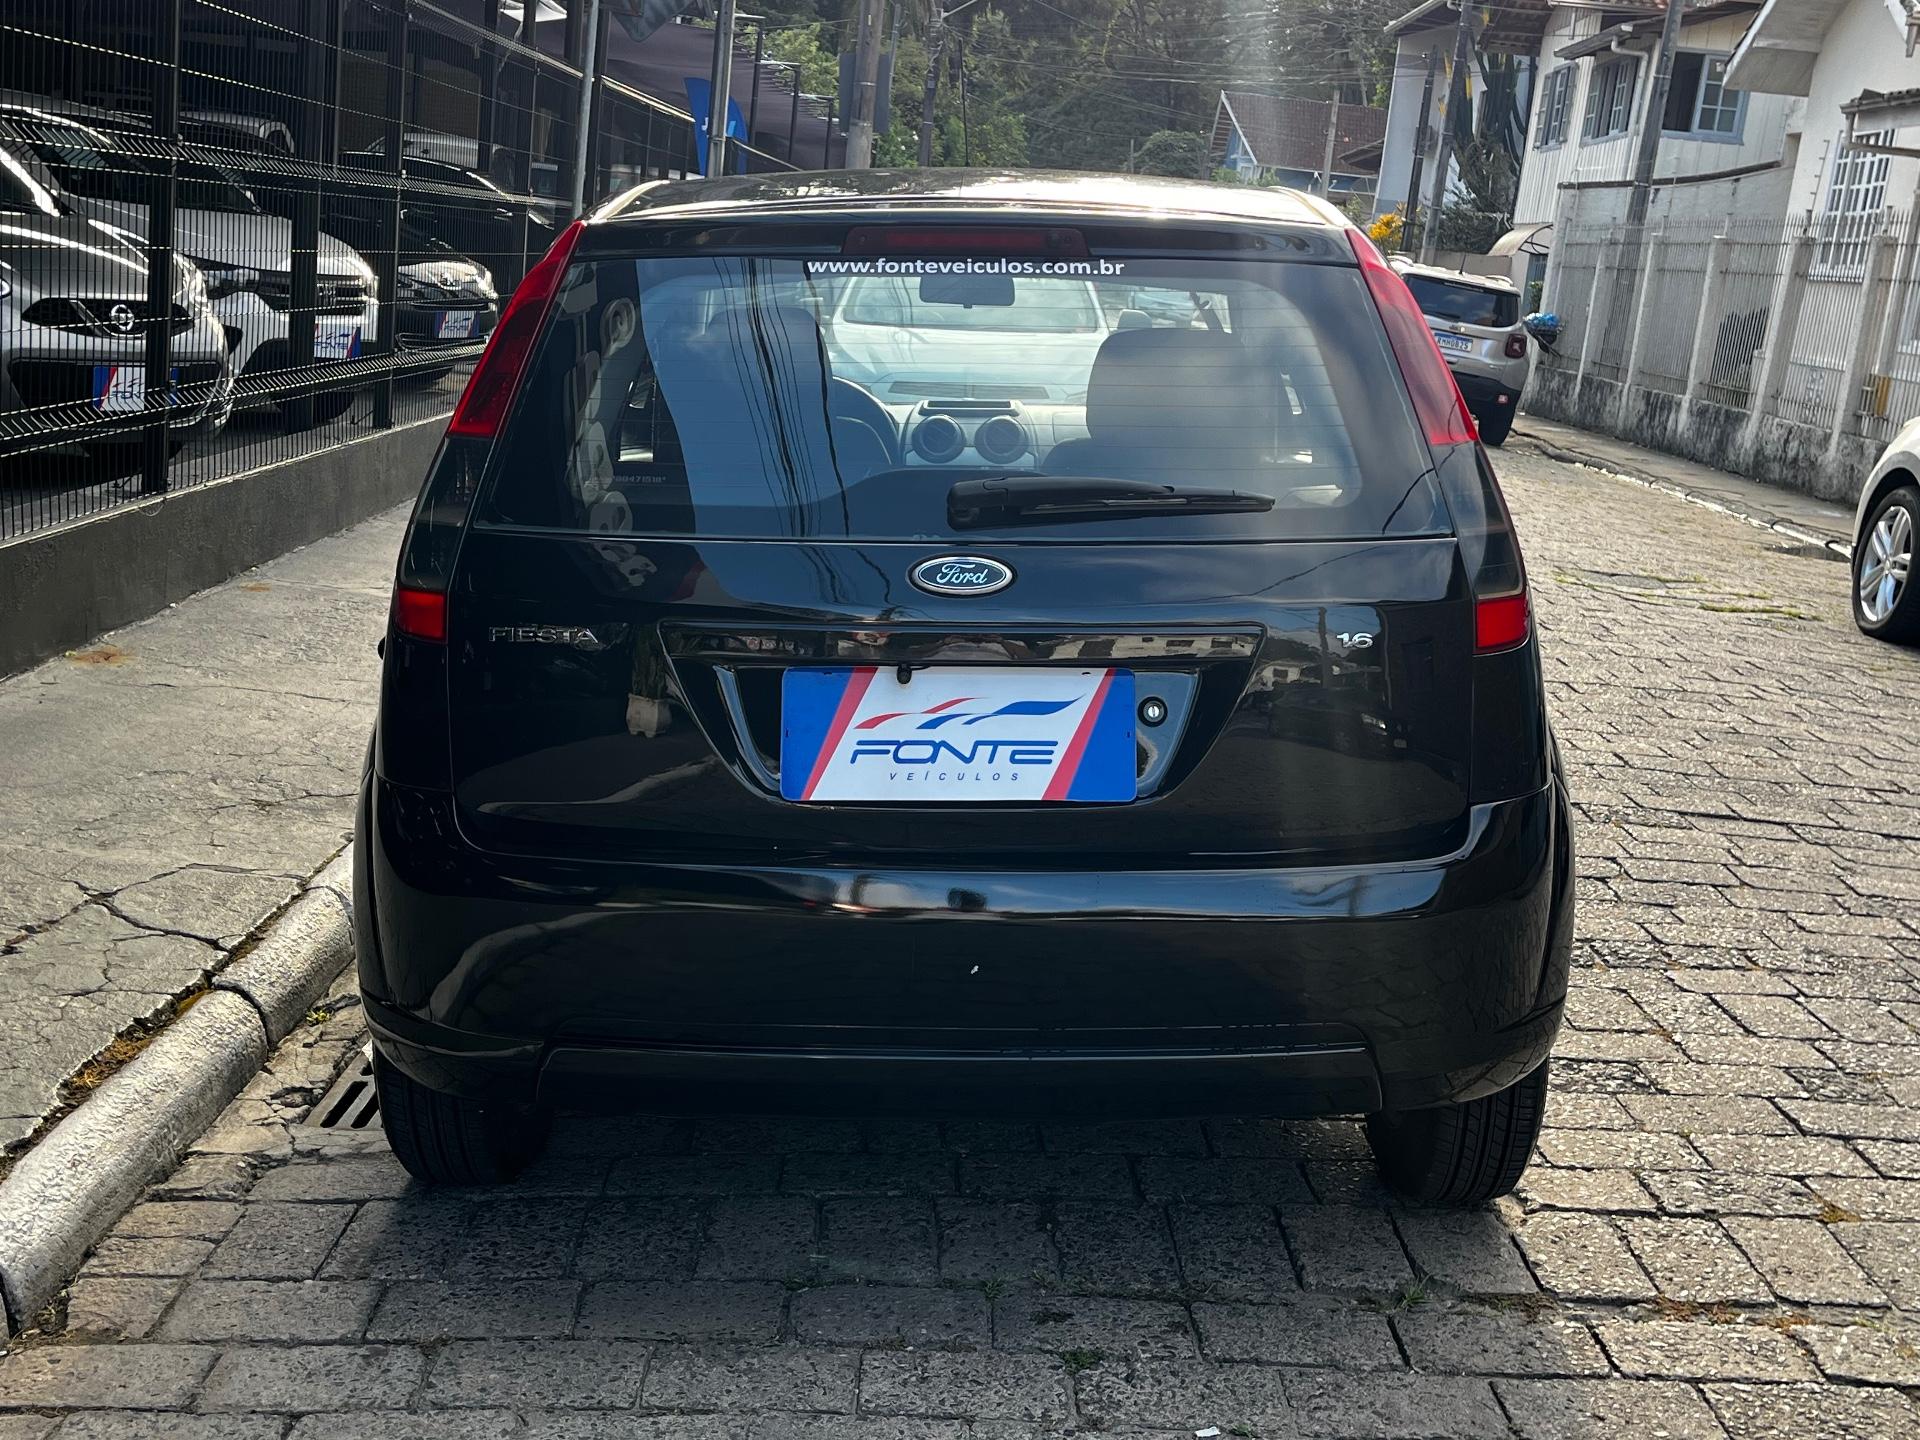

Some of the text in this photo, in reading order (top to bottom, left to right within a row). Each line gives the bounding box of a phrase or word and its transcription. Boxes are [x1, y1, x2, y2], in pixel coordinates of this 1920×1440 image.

[807, 257, 1125, 276] www.fonteveiculos.com.br
[936, 563, 989, 584] Ford
[488, 626, 599, 644] FIESTA
[850, 740, 1059, 765] FONTE
[889, 770, 1020, 782] VEÍCULOS
